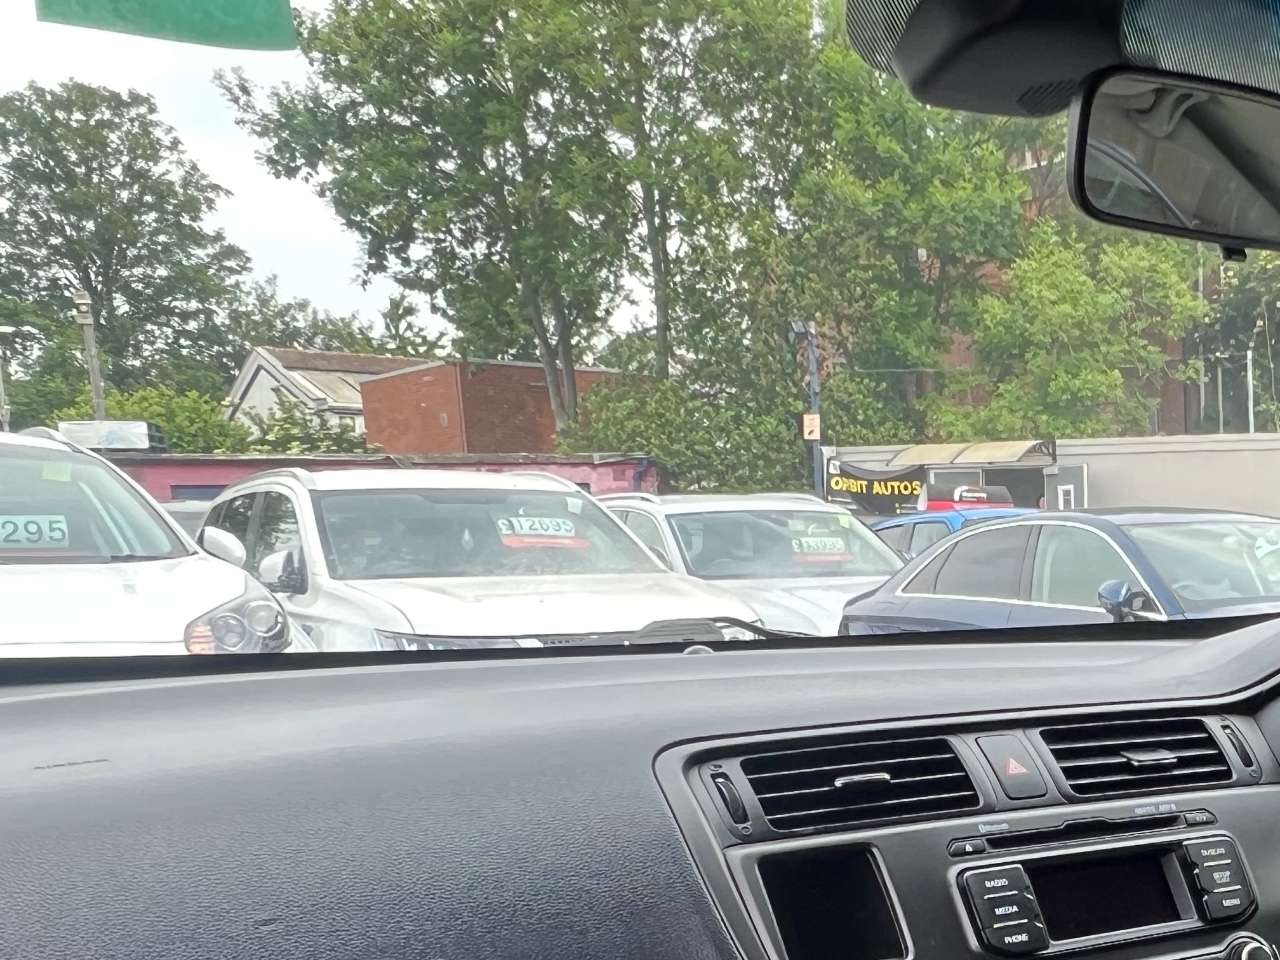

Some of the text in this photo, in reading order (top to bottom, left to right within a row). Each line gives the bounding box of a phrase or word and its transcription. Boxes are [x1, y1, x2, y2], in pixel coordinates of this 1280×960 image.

[830, 476, 922, 496] ORBIT AUTOS
[984, 878, 1009, 888] RADIO
[994, 905, 1019, 916] MEDIA
